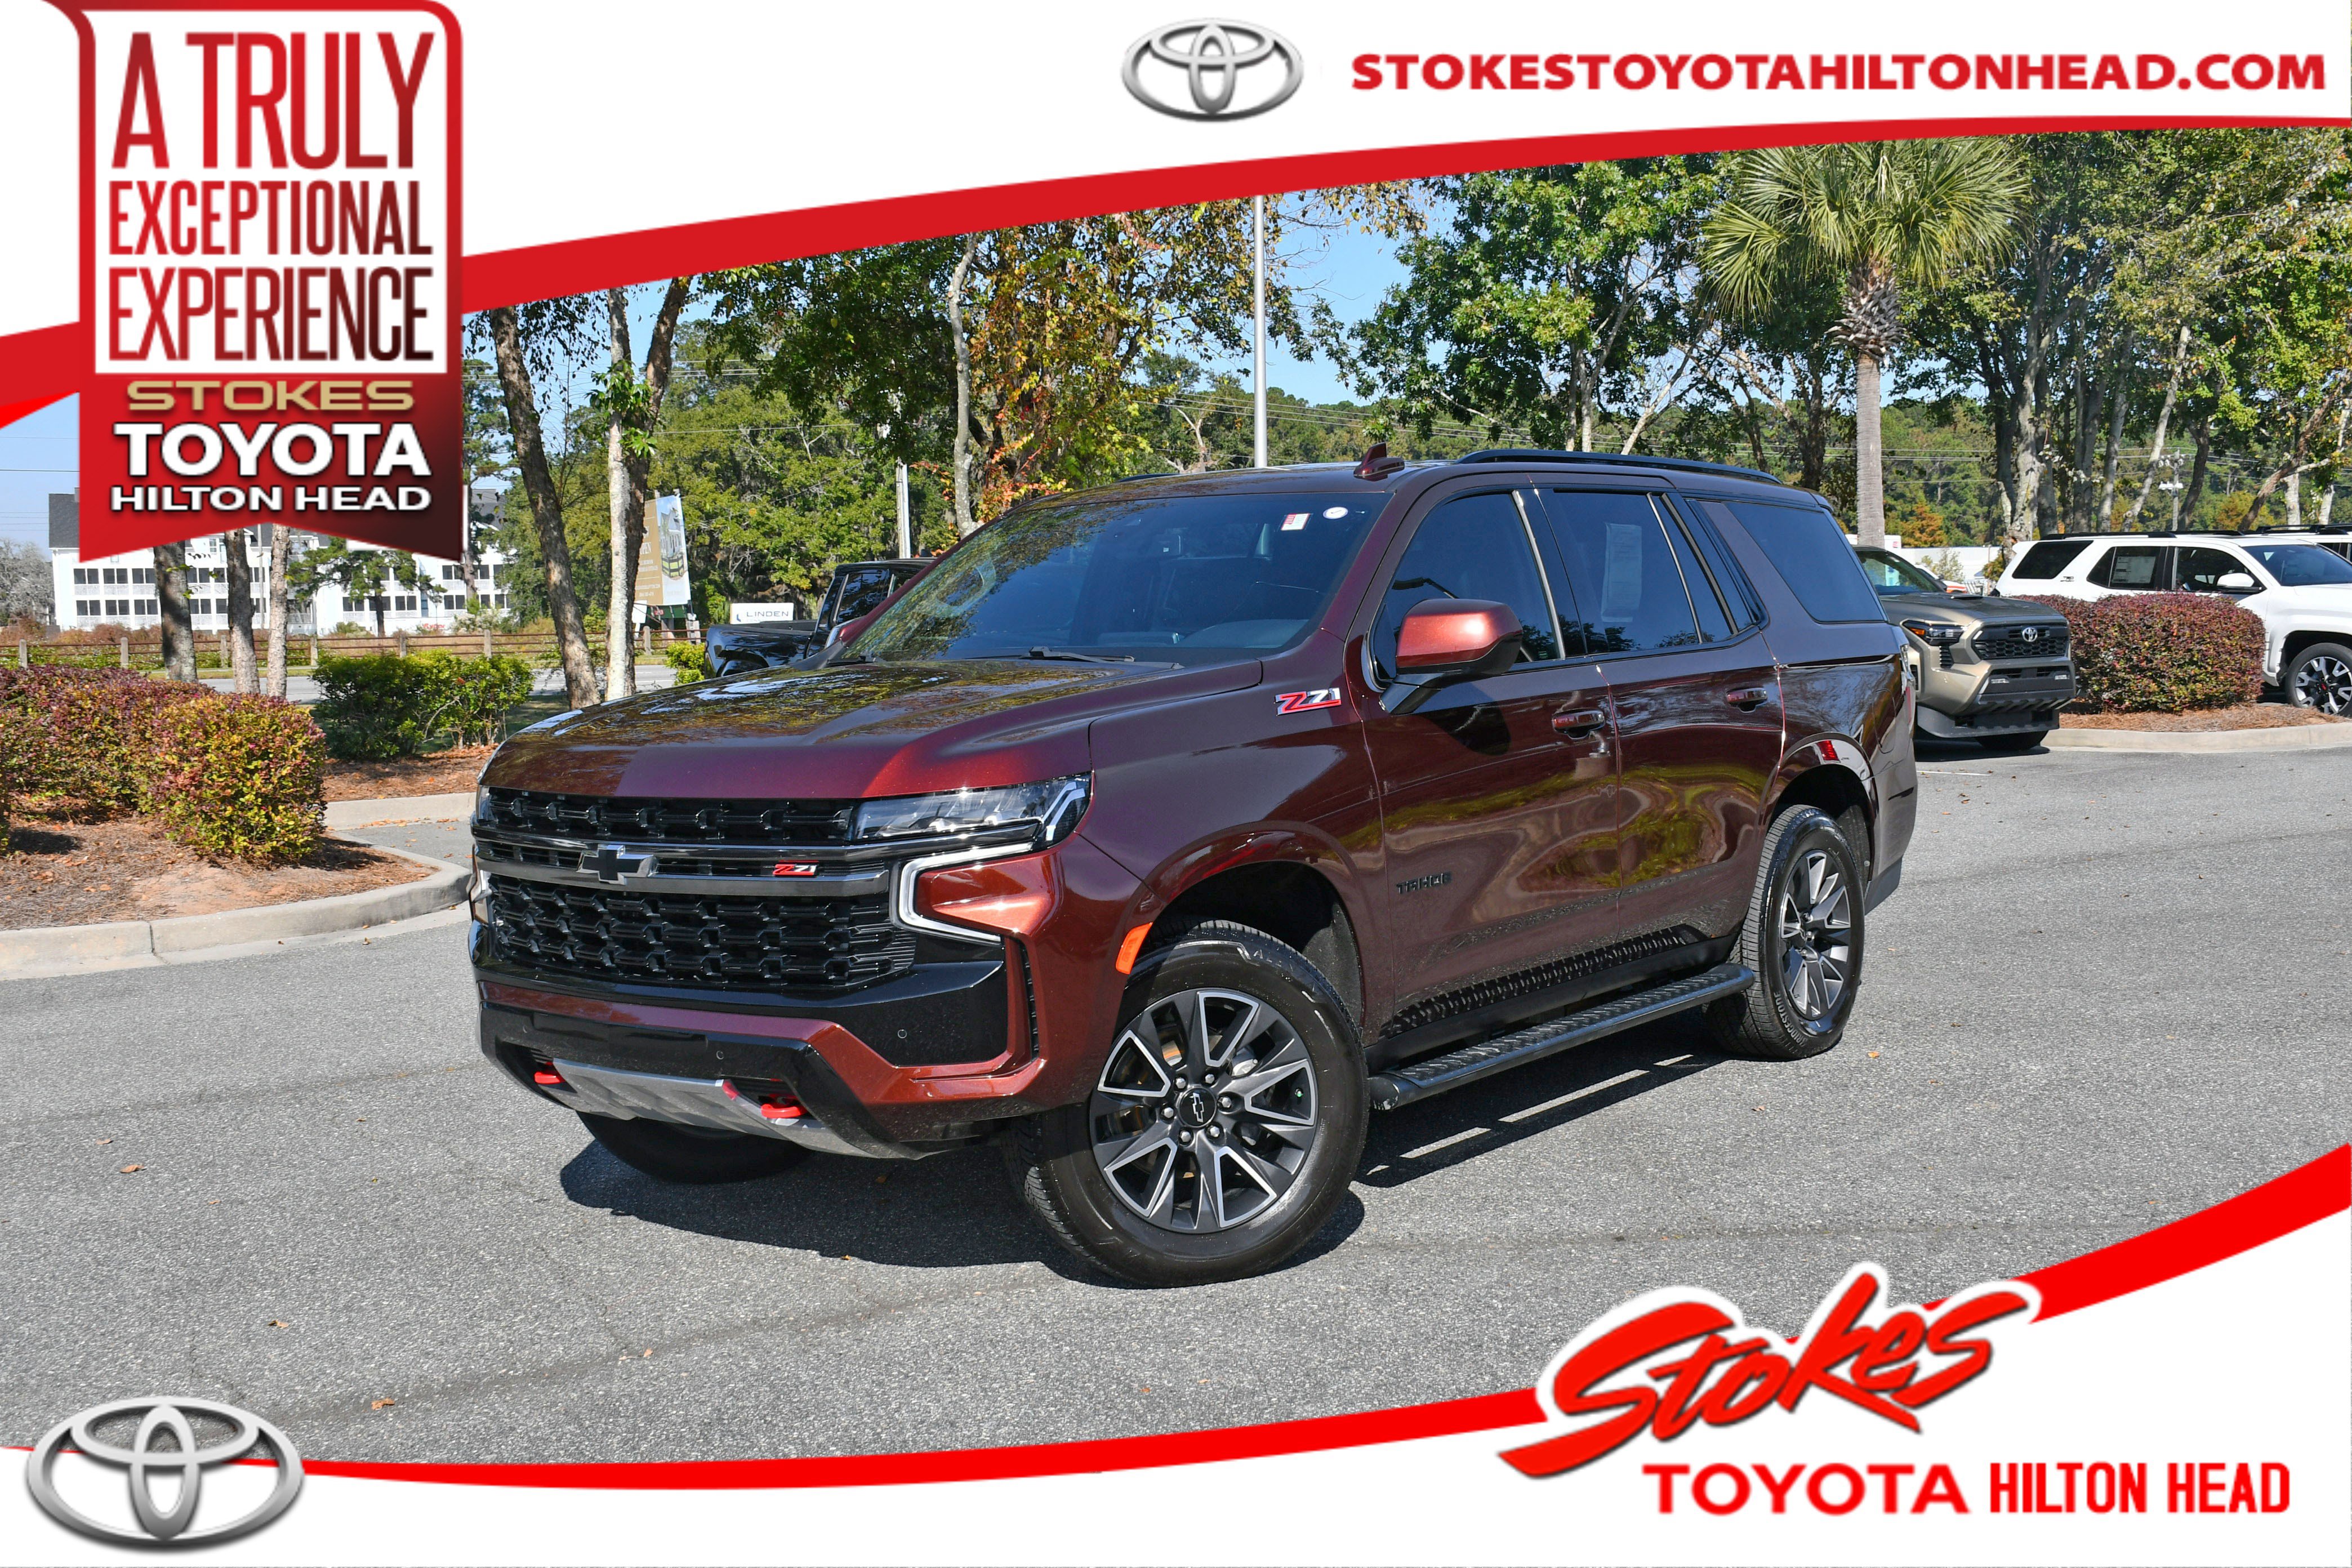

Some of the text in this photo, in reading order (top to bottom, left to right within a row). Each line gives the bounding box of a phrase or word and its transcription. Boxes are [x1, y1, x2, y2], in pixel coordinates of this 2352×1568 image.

[1275, 687, 1342, 715] Z71
[773, 863, 818, 876] Z71
[1396, 871, 1452, 894] TAHOE
